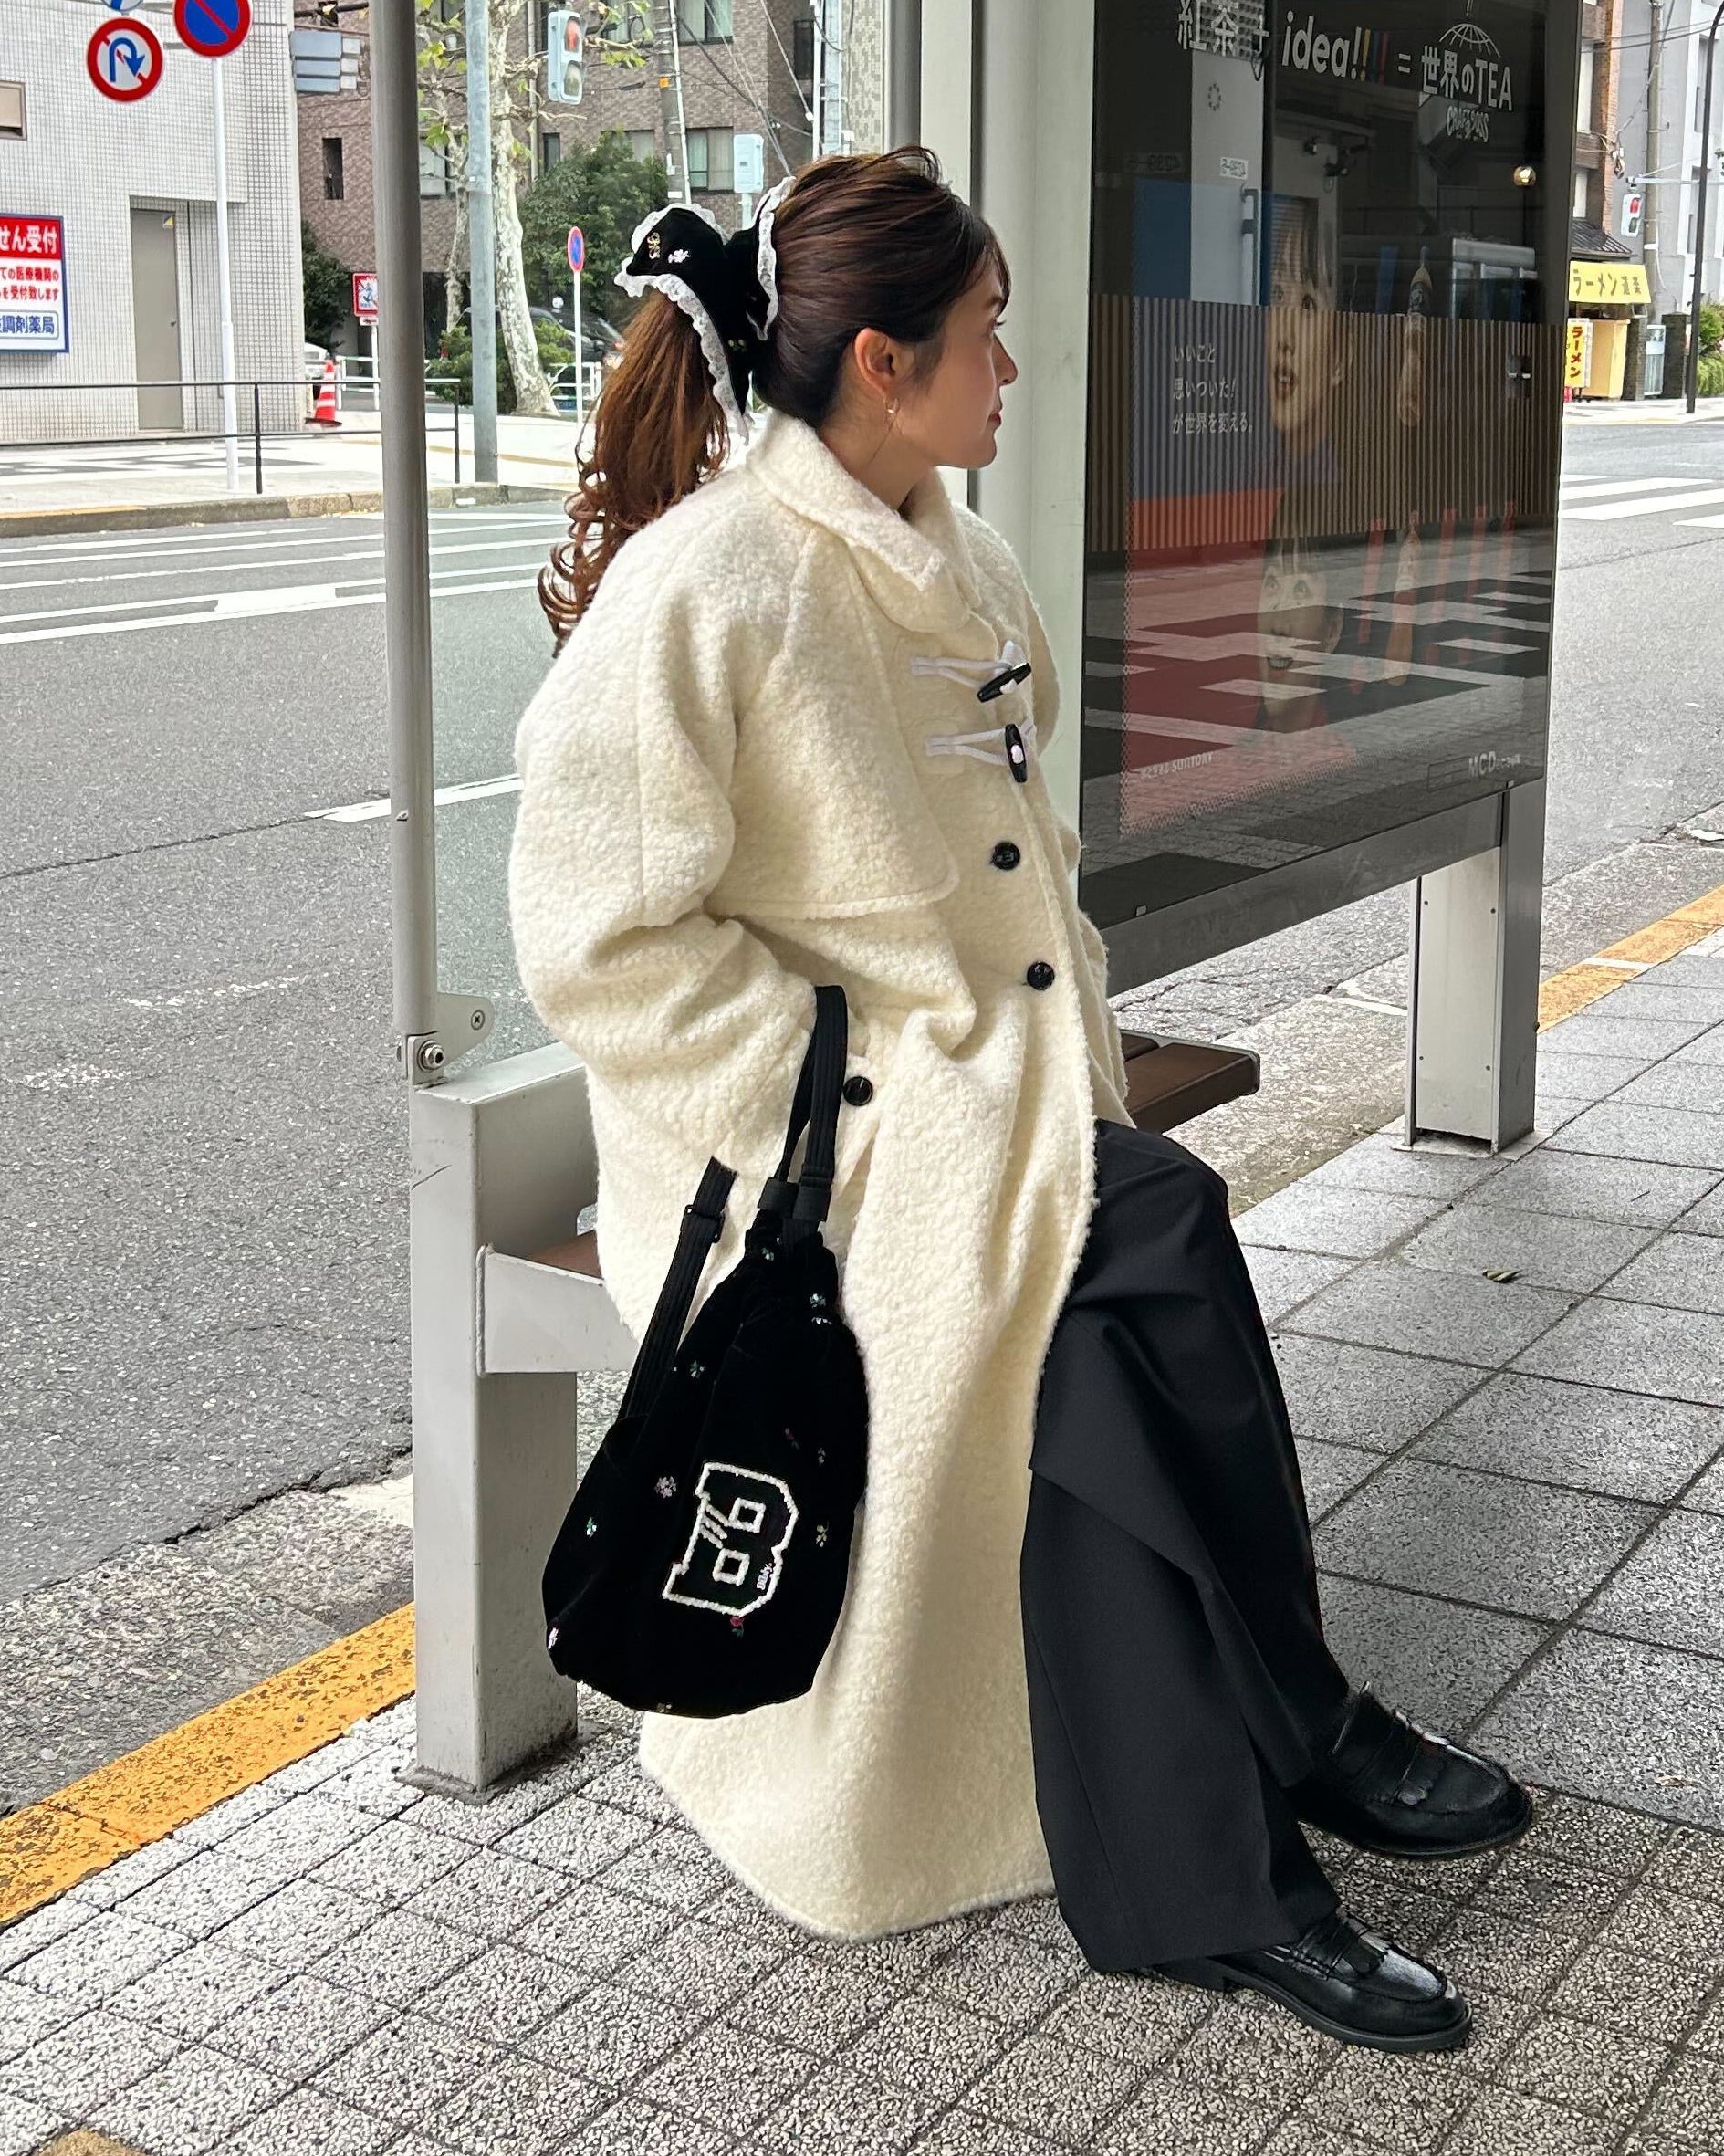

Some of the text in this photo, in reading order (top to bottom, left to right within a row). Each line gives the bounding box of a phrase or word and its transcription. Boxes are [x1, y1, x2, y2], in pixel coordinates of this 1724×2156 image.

[1421, 45, 1512, 111] 世界のTEA
[0, 225, 57, 255] せん受付
[0, 285, 59, 301] を受付致します
[0, 315, 55, 335] 調剤薬局
[1174, 344, 1216, 363] いいこと
[1570, 326, 1583, 378] ラーメン
